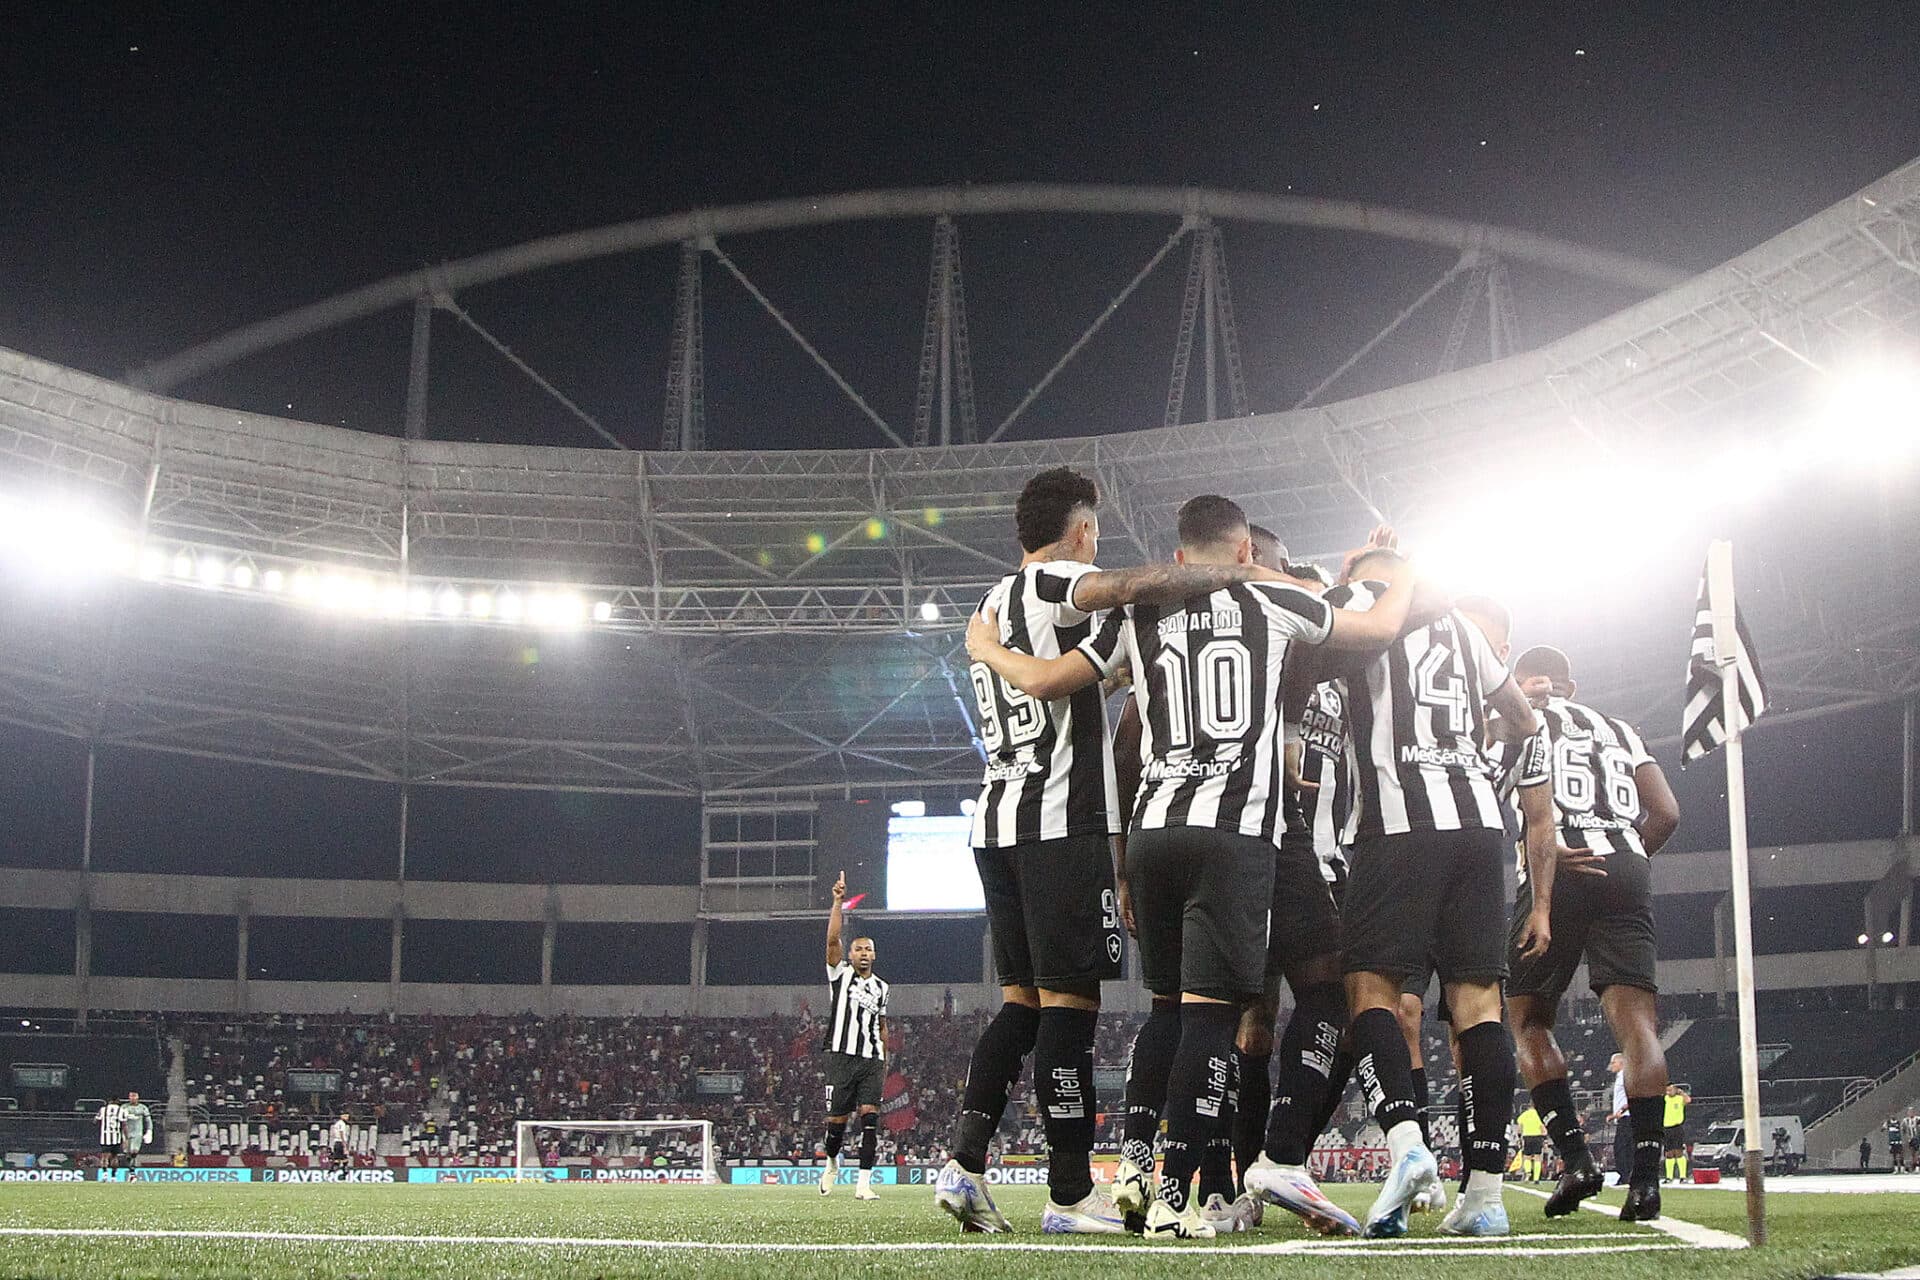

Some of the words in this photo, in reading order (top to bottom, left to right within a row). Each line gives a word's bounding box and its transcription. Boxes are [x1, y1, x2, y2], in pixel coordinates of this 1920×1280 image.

[1158, 610, 1243, 636] SAVARINO
[1155, 640, 1252, 746] 10
[1416, 642, 1468, 733] 4
[1149, 758, 1230, 778] MedSênior
[1553, 735, 1641, 820] 66
[1101, 889, 1120, 928] 9
[1472, 1140, 1501, 1151] BFR
[760, 1169, 884, 1184] PAYBRKES
[926, 1167, 1050, 1184] POKERS
